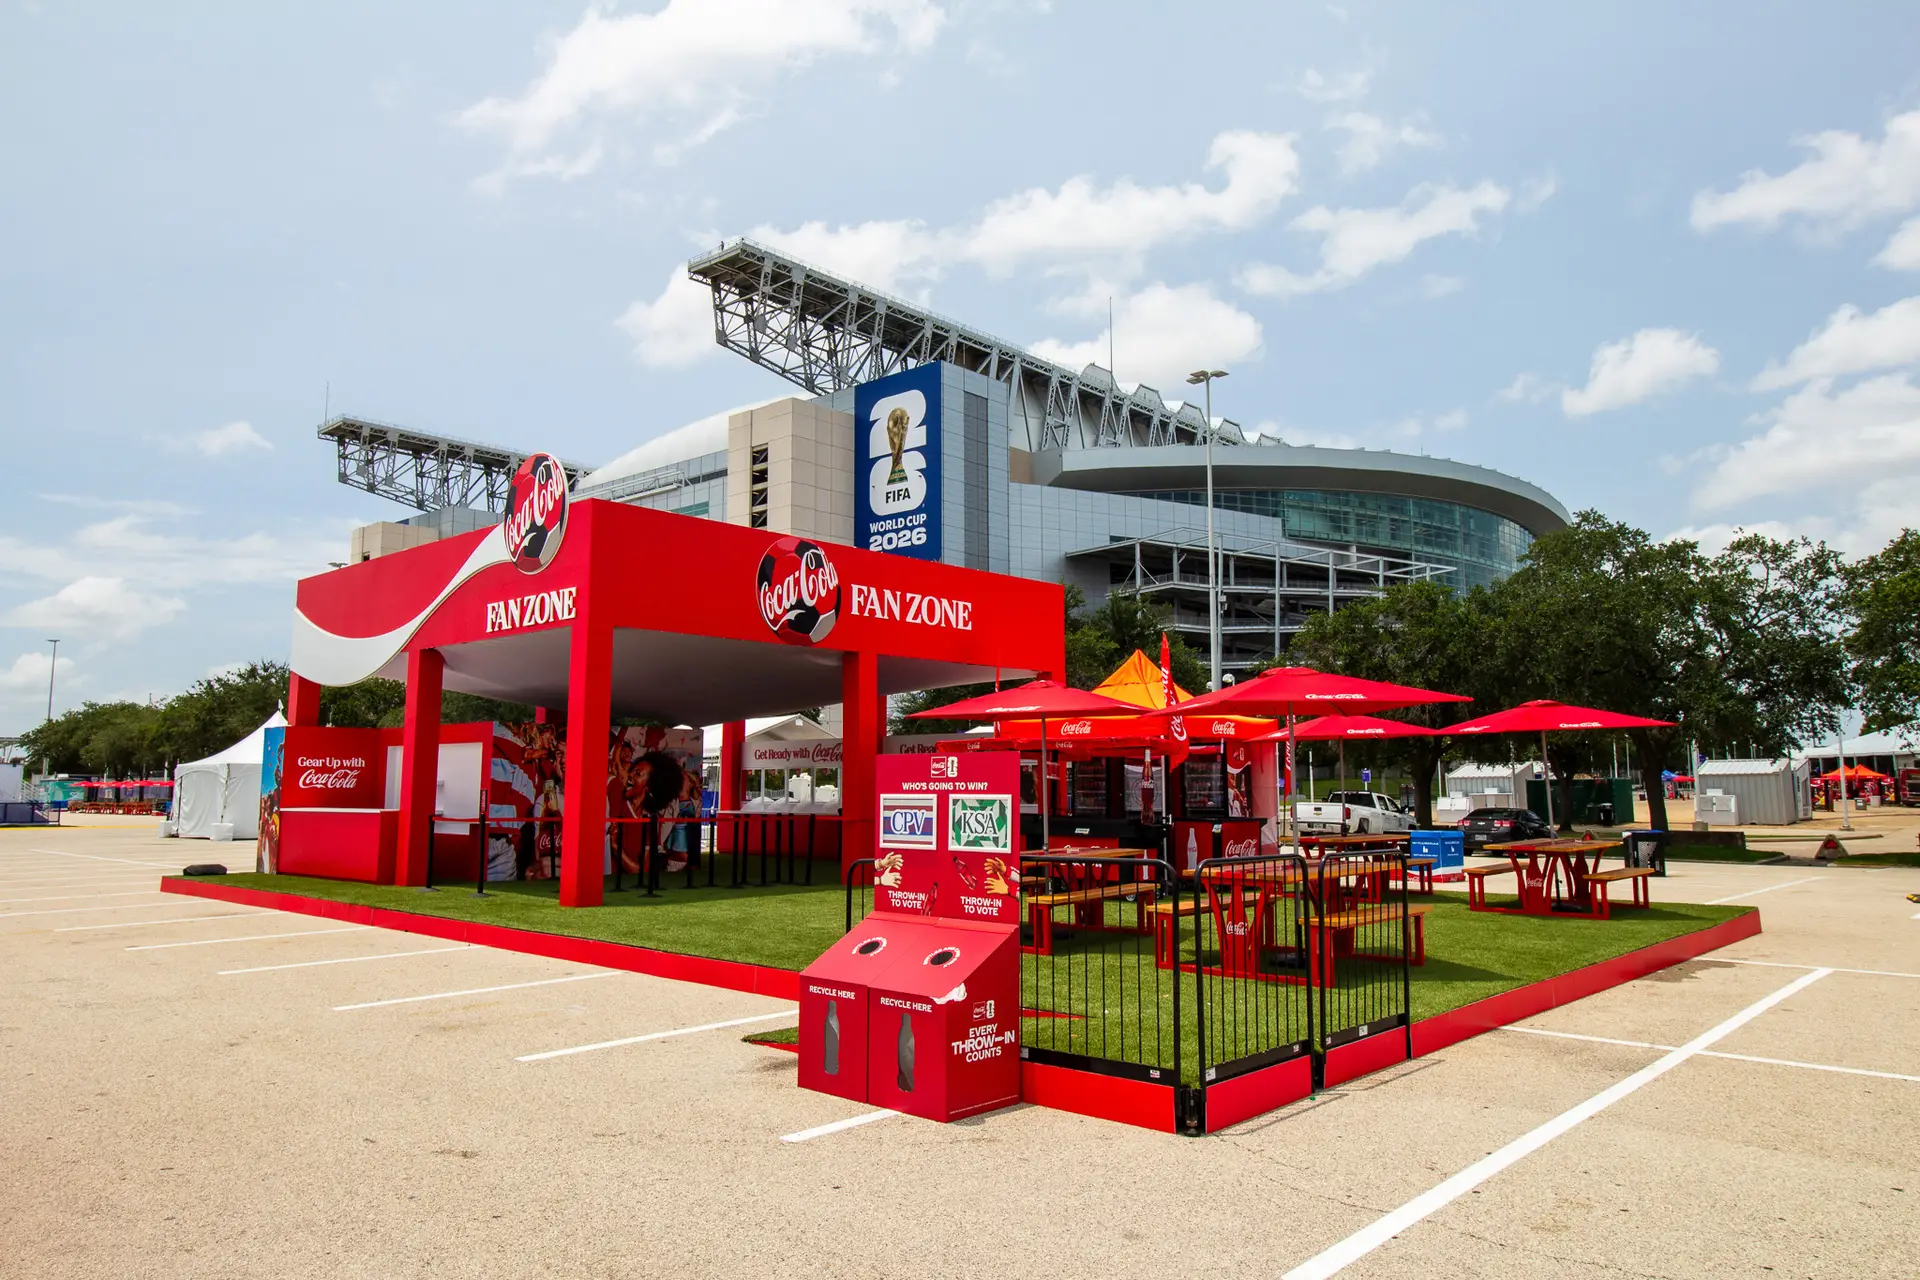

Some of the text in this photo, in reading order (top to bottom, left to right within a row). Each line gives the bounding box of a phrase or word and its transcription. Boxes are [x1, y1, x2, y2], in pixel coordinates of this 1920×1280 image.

[885, 487, 911, 504] FIFA
[505, 457, 564, 562] Coca-Cola
[869, 513, 927, 534] WORLD CUP
[869, 527, 927, 551] 2026
[760, 546, 839, 631] Coca-Cola
[486, 586, 577, 633] FAN ZONE
[851, 583, 972, 631] FAN ZONE
[1061, 720, 1092, 735] Coca-Cola
[1212, 721, 1235, 735] Coca-Cola
[754, 743, 843, 763] Get Ready with Coca-Co
[900, 744, 916, 755] Get
[297, 756, 366, 769] Gear Up with
[298, 768, 361, 789] Coca-Cola
[902, 782, 988, 790] WHO'S GOING TO WIN?
[891, 811, 925, 834] CPV
[961, 812, 998, 835] KSA
[1225, 839, 1258, 858] Coca-Cola
[888, 890, 926, 900] THROW-IN
[891, 898, 922, 909] TO VOTE
[960, 896, 1002, 907] THROW-IN
[964, 905, 999, 916] TO VOTE
[809, 985, 856, 1000] RECYCLE HERE
[880, 997, 932, 1013] RECYCLE HERE
[969, 1023, 998, 1038] EVERY
[951, 1030, 1015, 1055] THROW-IN
[966, 1046, 1002, 1063] COUNTS
